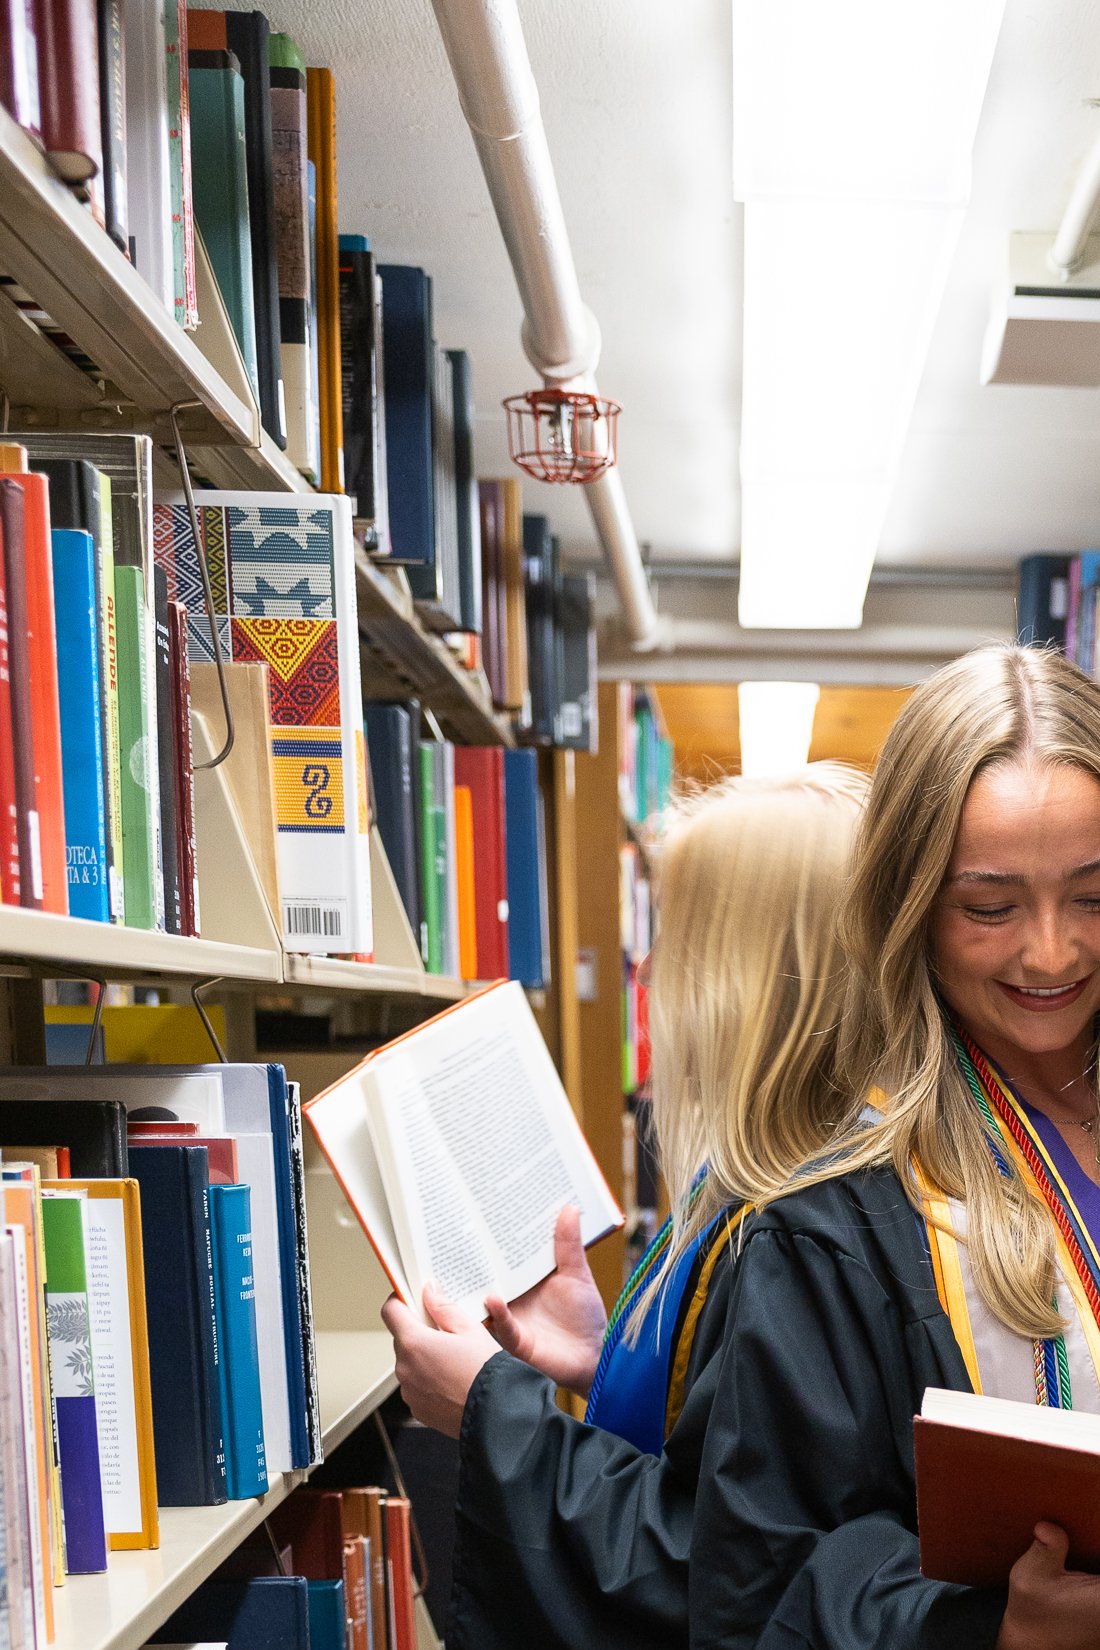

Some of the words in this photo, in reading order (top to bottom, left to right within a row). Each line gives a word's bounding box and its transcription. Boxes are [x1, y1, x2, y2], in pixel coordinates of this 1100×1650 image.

[107, 596, 116, 691] ALLENDE
[82, 866, 90, 884] &
[92, 866, 99, 886] 3
